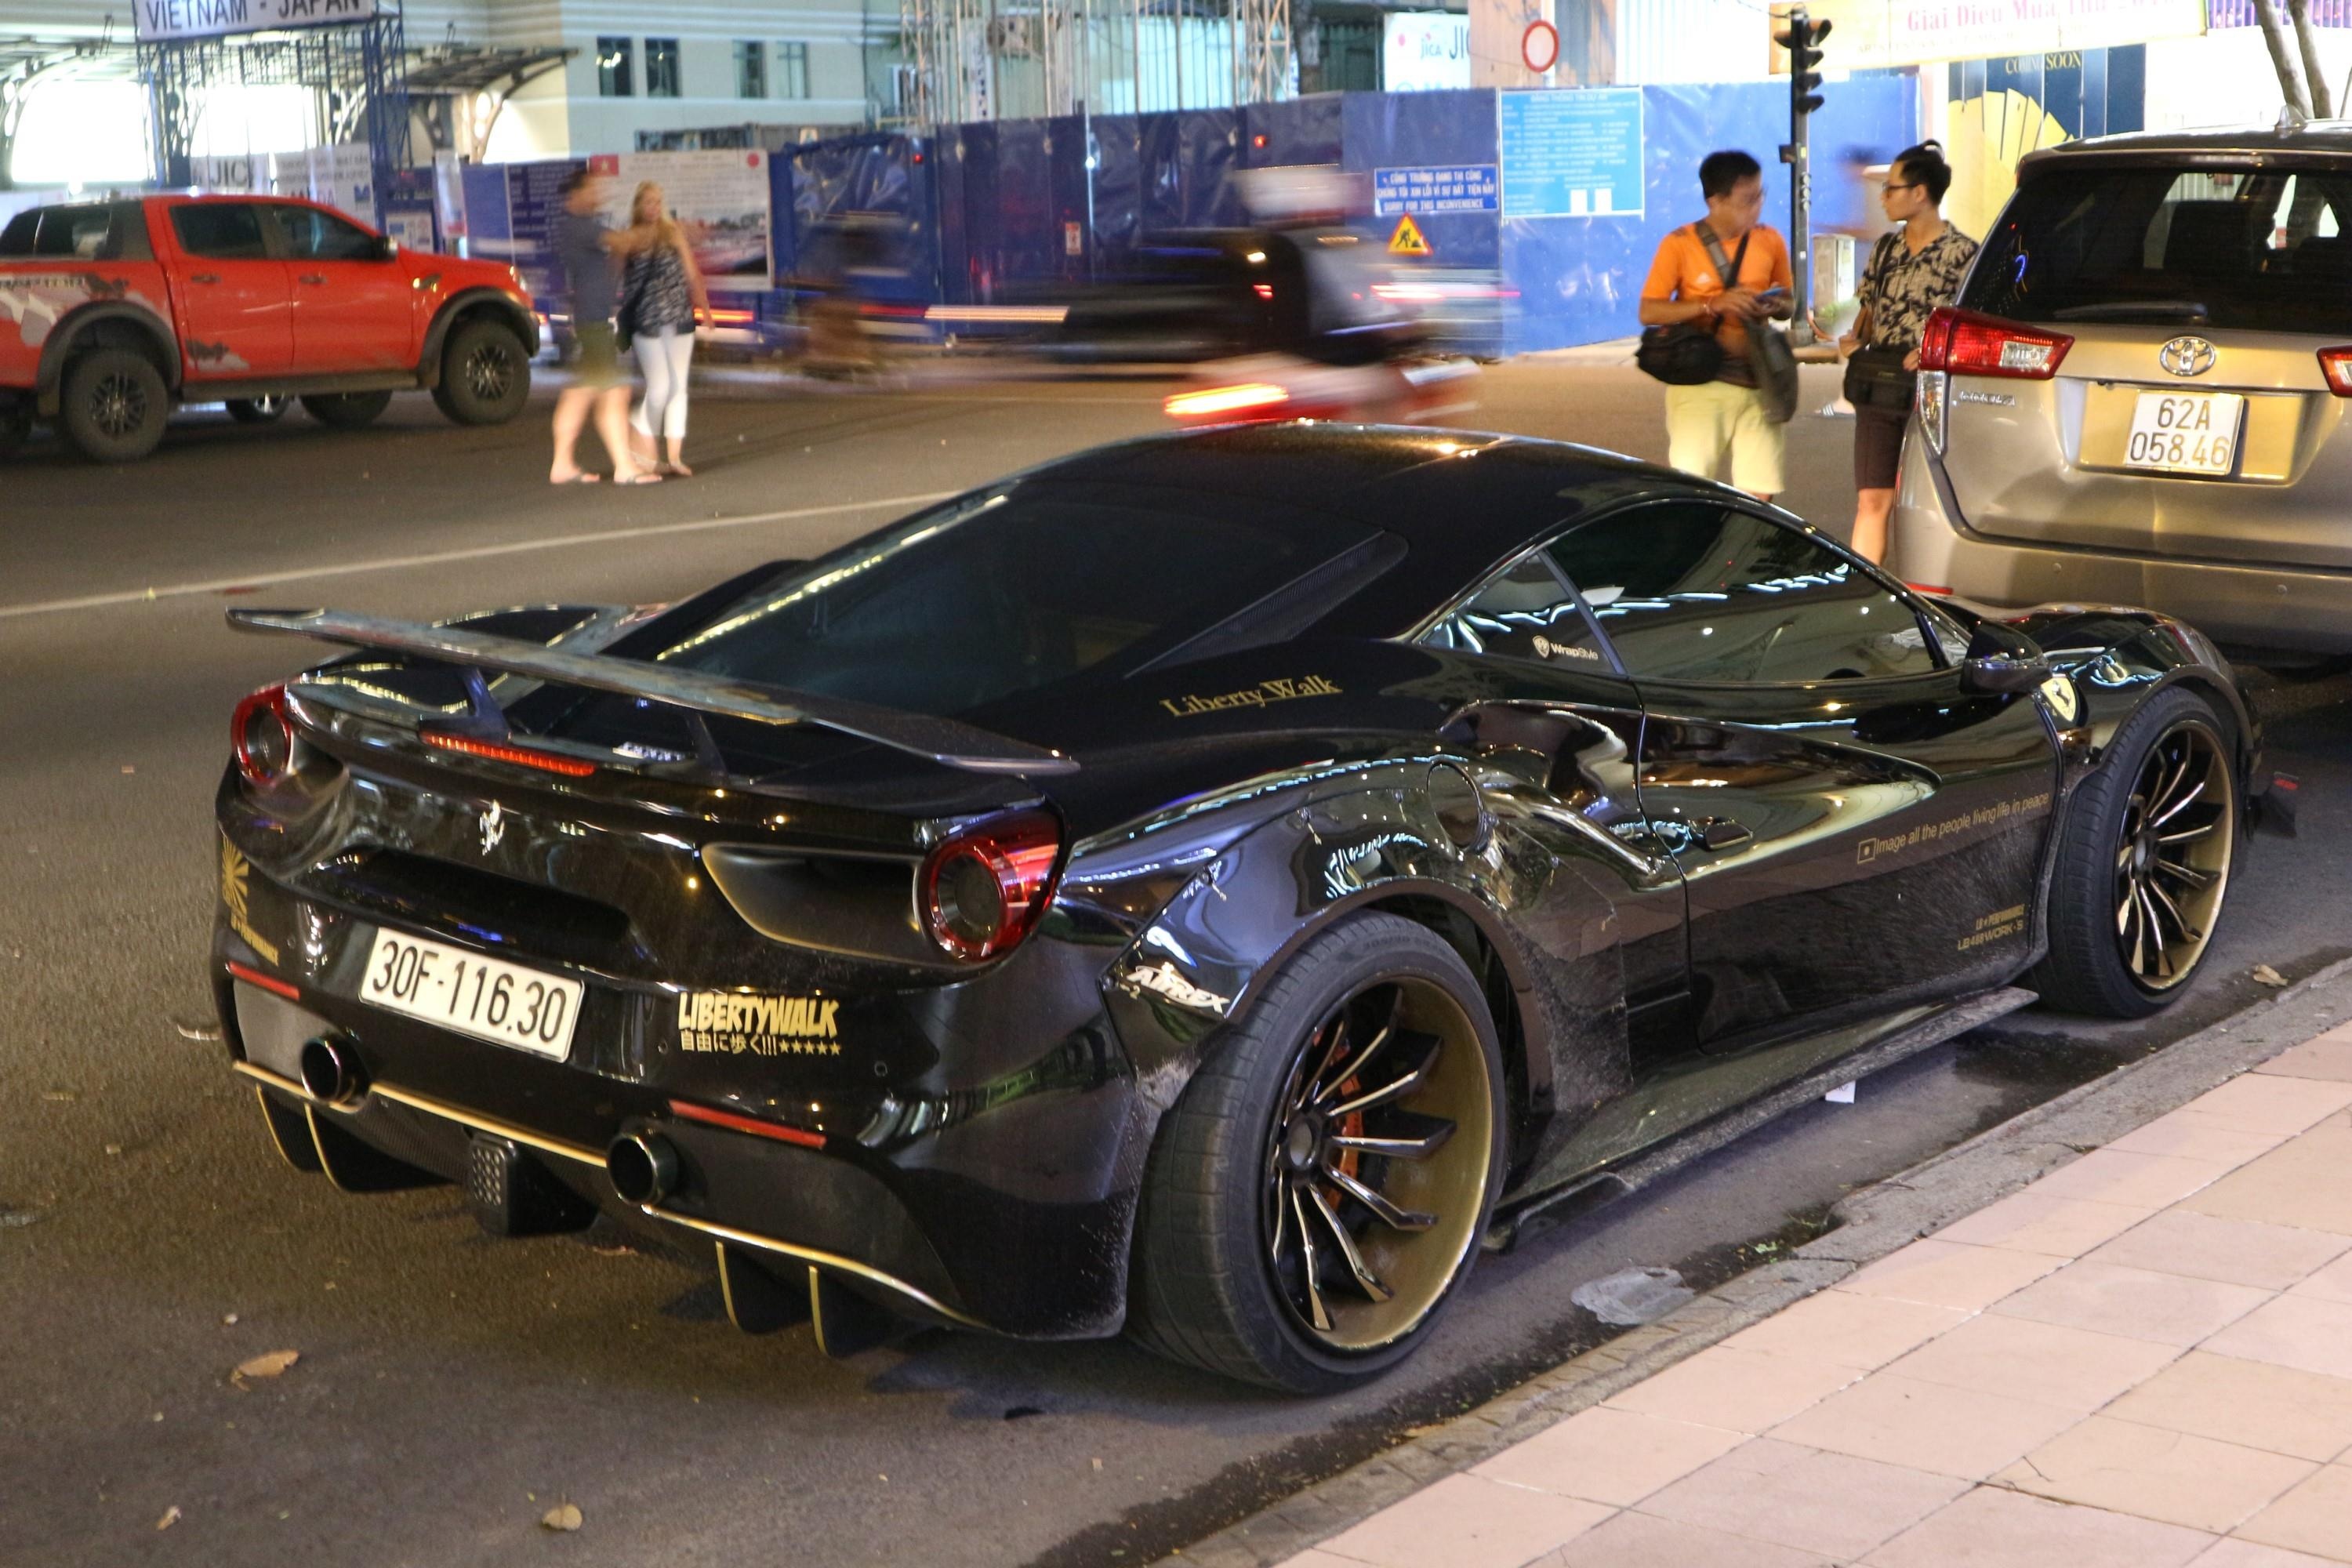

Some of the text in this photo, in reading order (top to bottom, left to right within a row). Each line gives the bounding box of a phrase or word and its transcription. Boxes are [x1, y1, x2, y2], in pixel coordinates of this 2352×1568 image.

[147, 0, 249, 31] VIETNAM
[2005, 51, 2082, 75] COMIN SOON
[2157, 397, 2212, 431] 62A
[2129, 430, 2230, 467] 058.46
[1160, 674, 1343, 717] Liberty Walk
[1875, 792, 2049, 854] Image all the people living life in peace
[372, 940, 568, 1044] 30F-116.30
